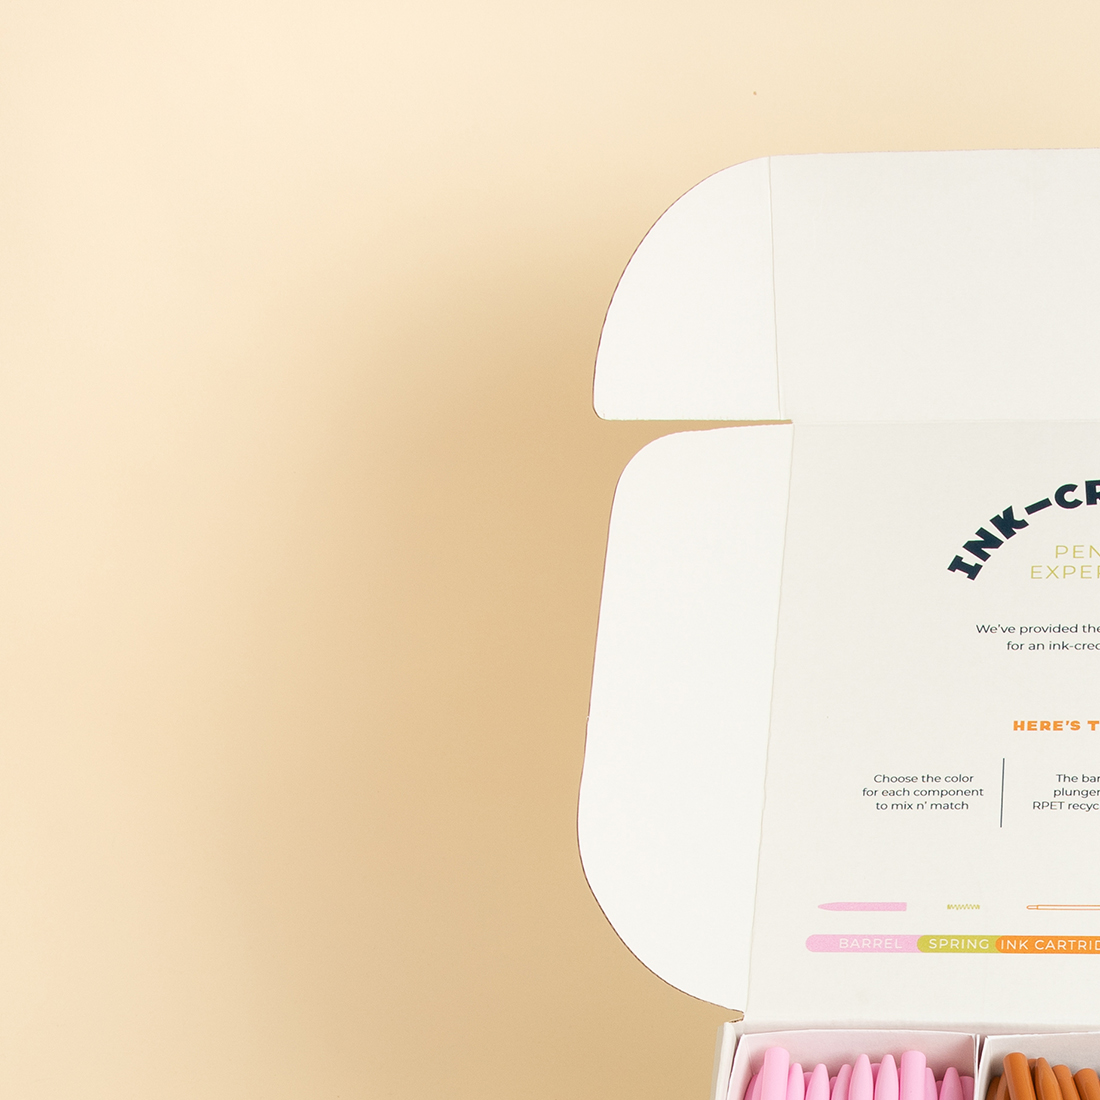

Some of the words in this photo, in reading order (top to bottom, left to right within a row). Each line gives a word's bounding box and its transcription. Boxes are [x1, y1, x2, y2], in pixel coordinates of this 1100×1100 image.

[975, 623, 1016, 634] We’ve
[1019, 623, 1079, 636] provided
[1006, 640, 1025, 651] for
[1028, 642, 1045, 651] an
[1013, 721, 1080, 731] HERE’S
[873, 774, 919, 784] Choose
[921, 773, 942, 783] the
[944, 773, 974, 783] color
[1056, 773, 1079, 783] The
[862, 787, 879, 797] for
[881, 787, 911, 797] each
[913, 788, 984, 799] component
[875, 802, 889, 811] to
[890, 800, 914, 810] mix
[916, 800, 928, 810] n’
[930, 800, 969, 811] match
[1032, 800, 1065, 810] RPET
[839, 937, 903, 950] BARREL
[928, 938, 990, 950] SPRING
[1000, 939, 1029, 950] INK
